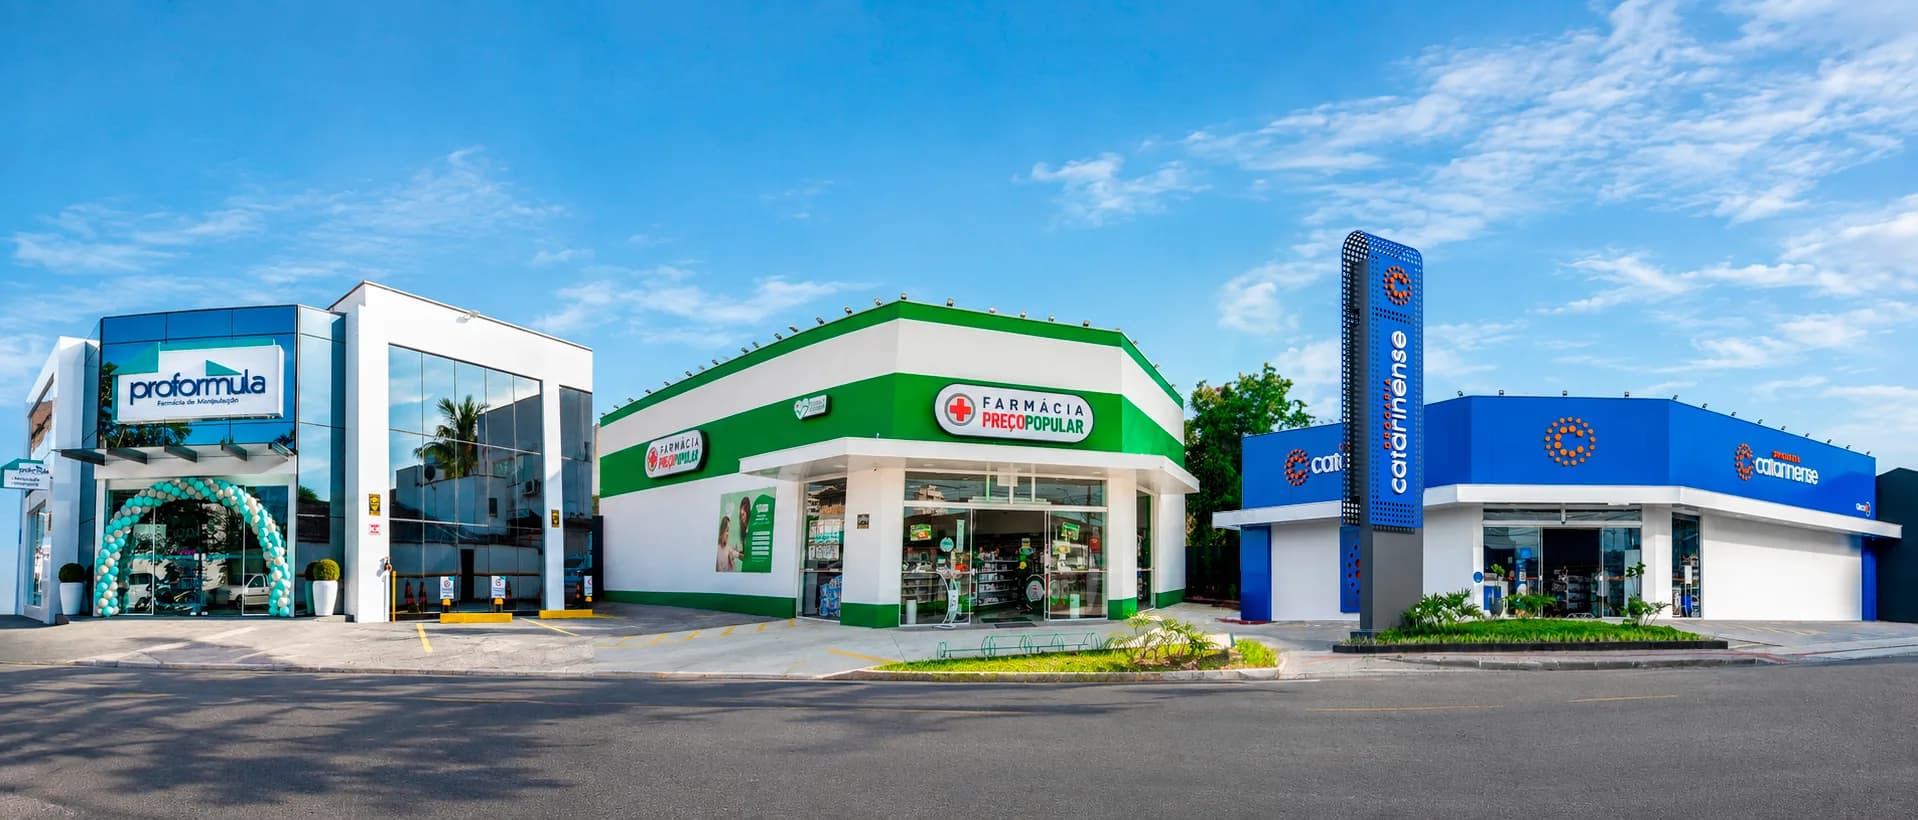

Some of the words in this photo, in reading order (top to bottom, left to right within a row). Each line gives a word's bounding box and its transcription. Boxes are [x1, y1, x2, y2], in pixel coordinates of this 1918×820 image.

[130, 369, 266, 405] proformula
[983, 396, 1085, 417] FARMÁCIA
[1390, 330, 1408, 495] catarinense
[660, 436, 699, 454] FARMÁCIA
